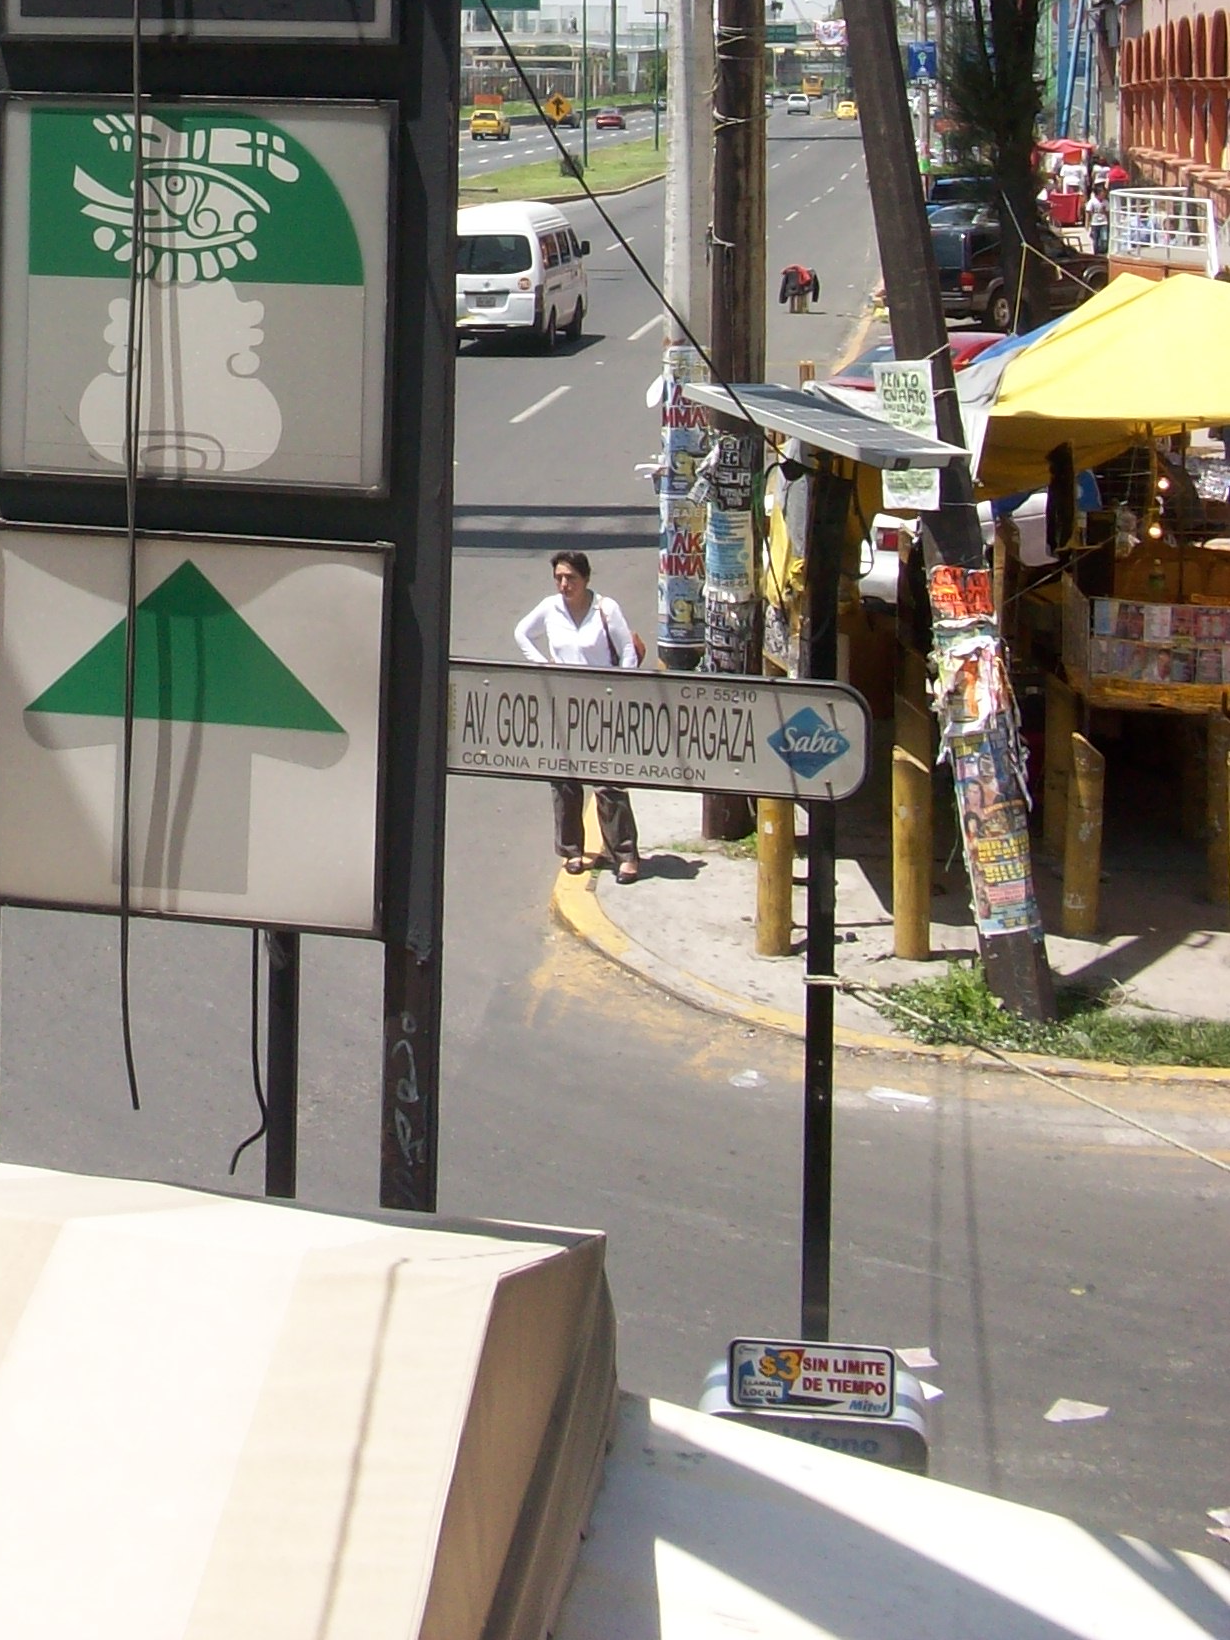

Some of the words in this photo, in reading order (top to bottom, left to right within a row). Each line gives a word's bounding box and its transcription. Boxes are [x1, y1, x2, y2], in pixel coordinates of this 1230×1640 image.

[680, 686, 708, 701] C.P.
[713, 687, 758, 703] 55210
[462, 691, 490, 745] AV.
[497, 691, 544, 749] GOB.
[550, 696, 560, 751] I.
[567, 696, 671, 758] PICHARDO
[676, 704, 757, 764] PAGAZA
[779, 726, 840, 754] Saba
[462, 751, 531, 769] COLONIA
[537, 756, 610, 775] FUENTES
[613, 762, 636, 776] DE
[758, 1350, 801, 1381] $3
[802, 1357, 828, 1372] SIN
[833, 1358, 886, 1376] LIMITE
[742, 1388, 779, 1398] LOCAL
[802, 1376, 824, 1391] DE
[826, 1378, 886, 1397] TIEMPO
